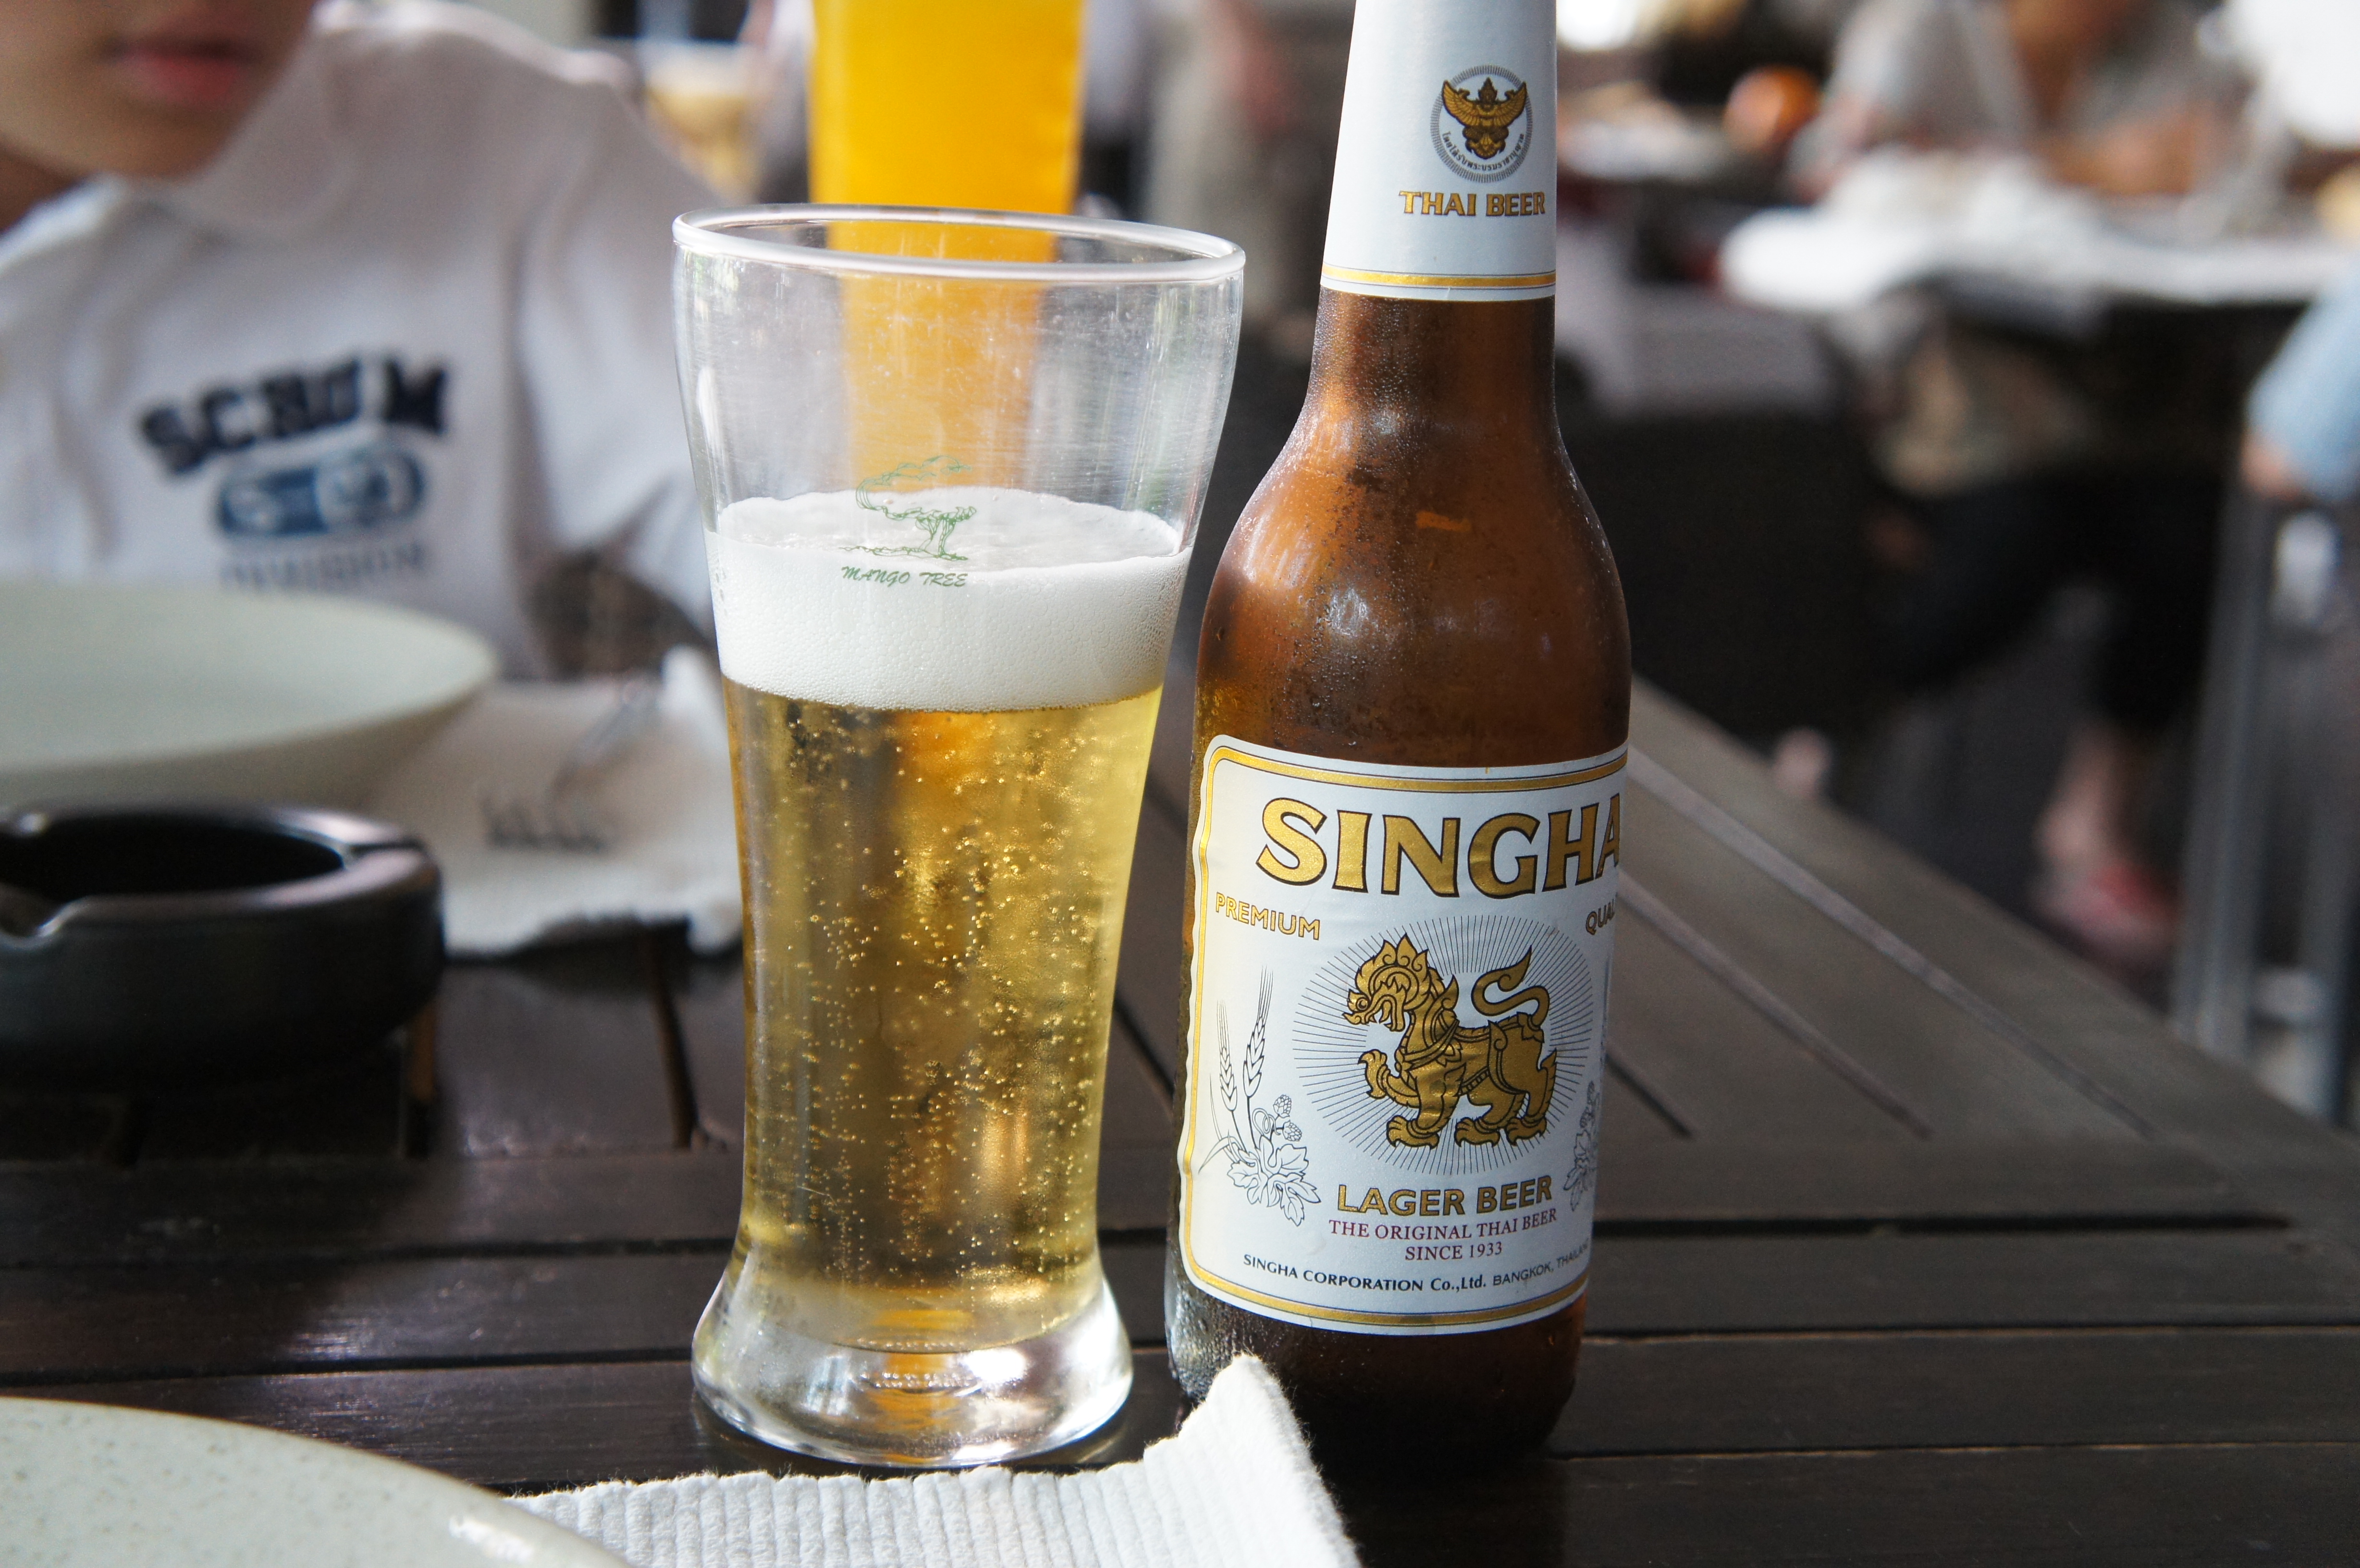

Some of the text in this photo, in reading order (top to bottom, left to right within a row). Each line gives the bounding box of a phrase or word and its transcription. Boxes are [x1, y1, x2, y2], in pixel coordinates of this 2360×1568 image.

[1399, 190, 1546, 217] THAI BEER
[841, 566, 968, 587] MANGO TREE
[1256, 793, 1620, 899] SINGHA
[1216, 892, 1320, 941] PREMIUM
[1337, 1175, 1552, 1216] LAGER BEER
[1329, 1208, 1557, 1241] THE ORIGINAL THAI BEER
[1405, 1241, 1502, 1261] SINCE 1933
[1243, 1254, 1298, 1279] SINGHA
[1303, 1270, 1424, 1292] CORPORATION
[1493, 1262, 1554, 1286] BANGKOK,
